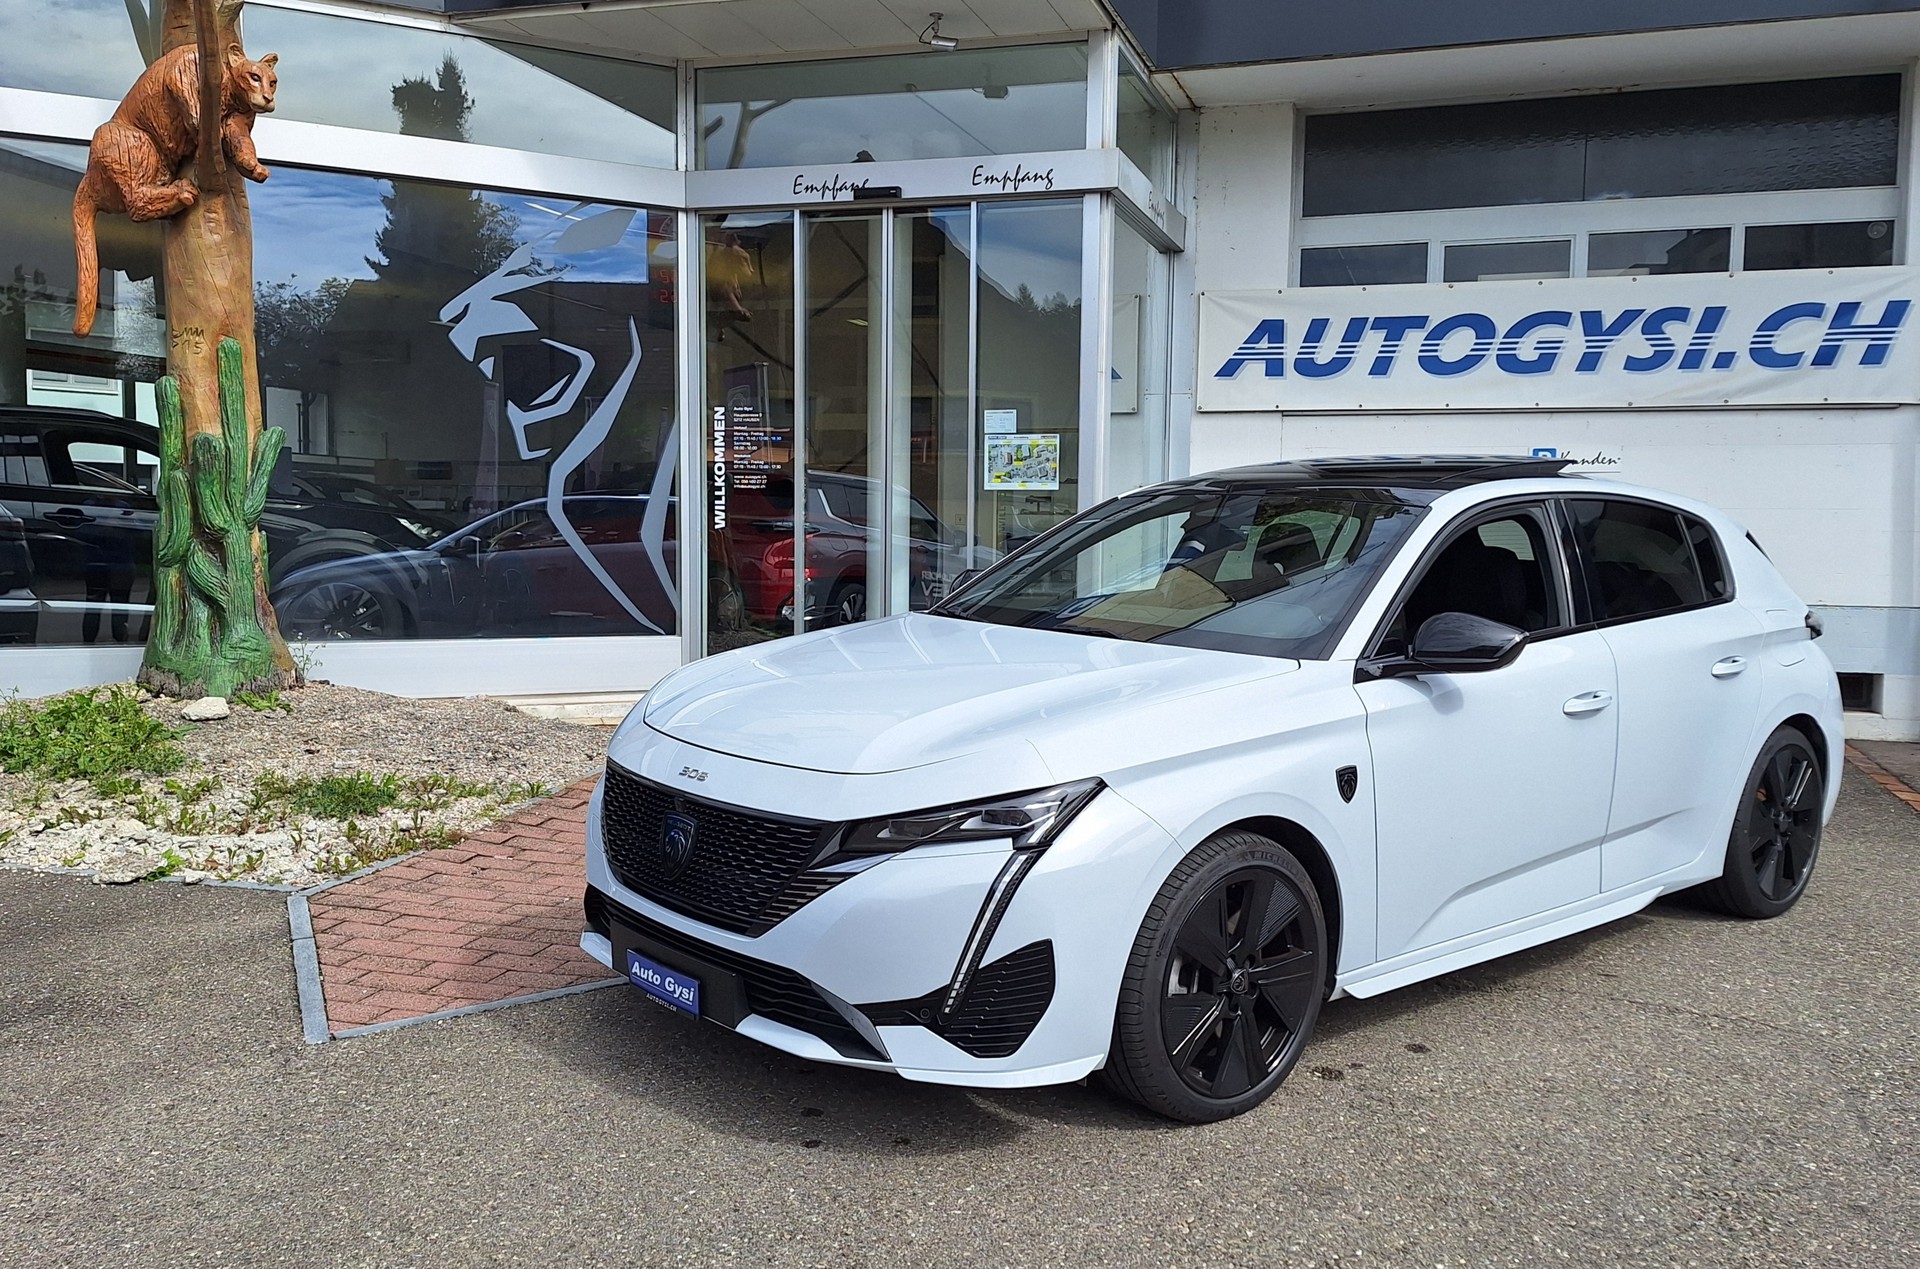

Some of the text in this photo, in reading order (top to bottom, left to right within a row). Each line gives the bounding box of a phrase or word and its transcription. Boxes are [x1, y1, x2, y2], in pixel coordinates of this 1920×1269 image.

[971, 164, 1054, 191] Empfang
[1214, 299, 1912, 380] AUTOGYSI.CH
[714, 407, 725, 529] WILLKOMMEN
[631, 961, 695, 1002] Auto Gysi
